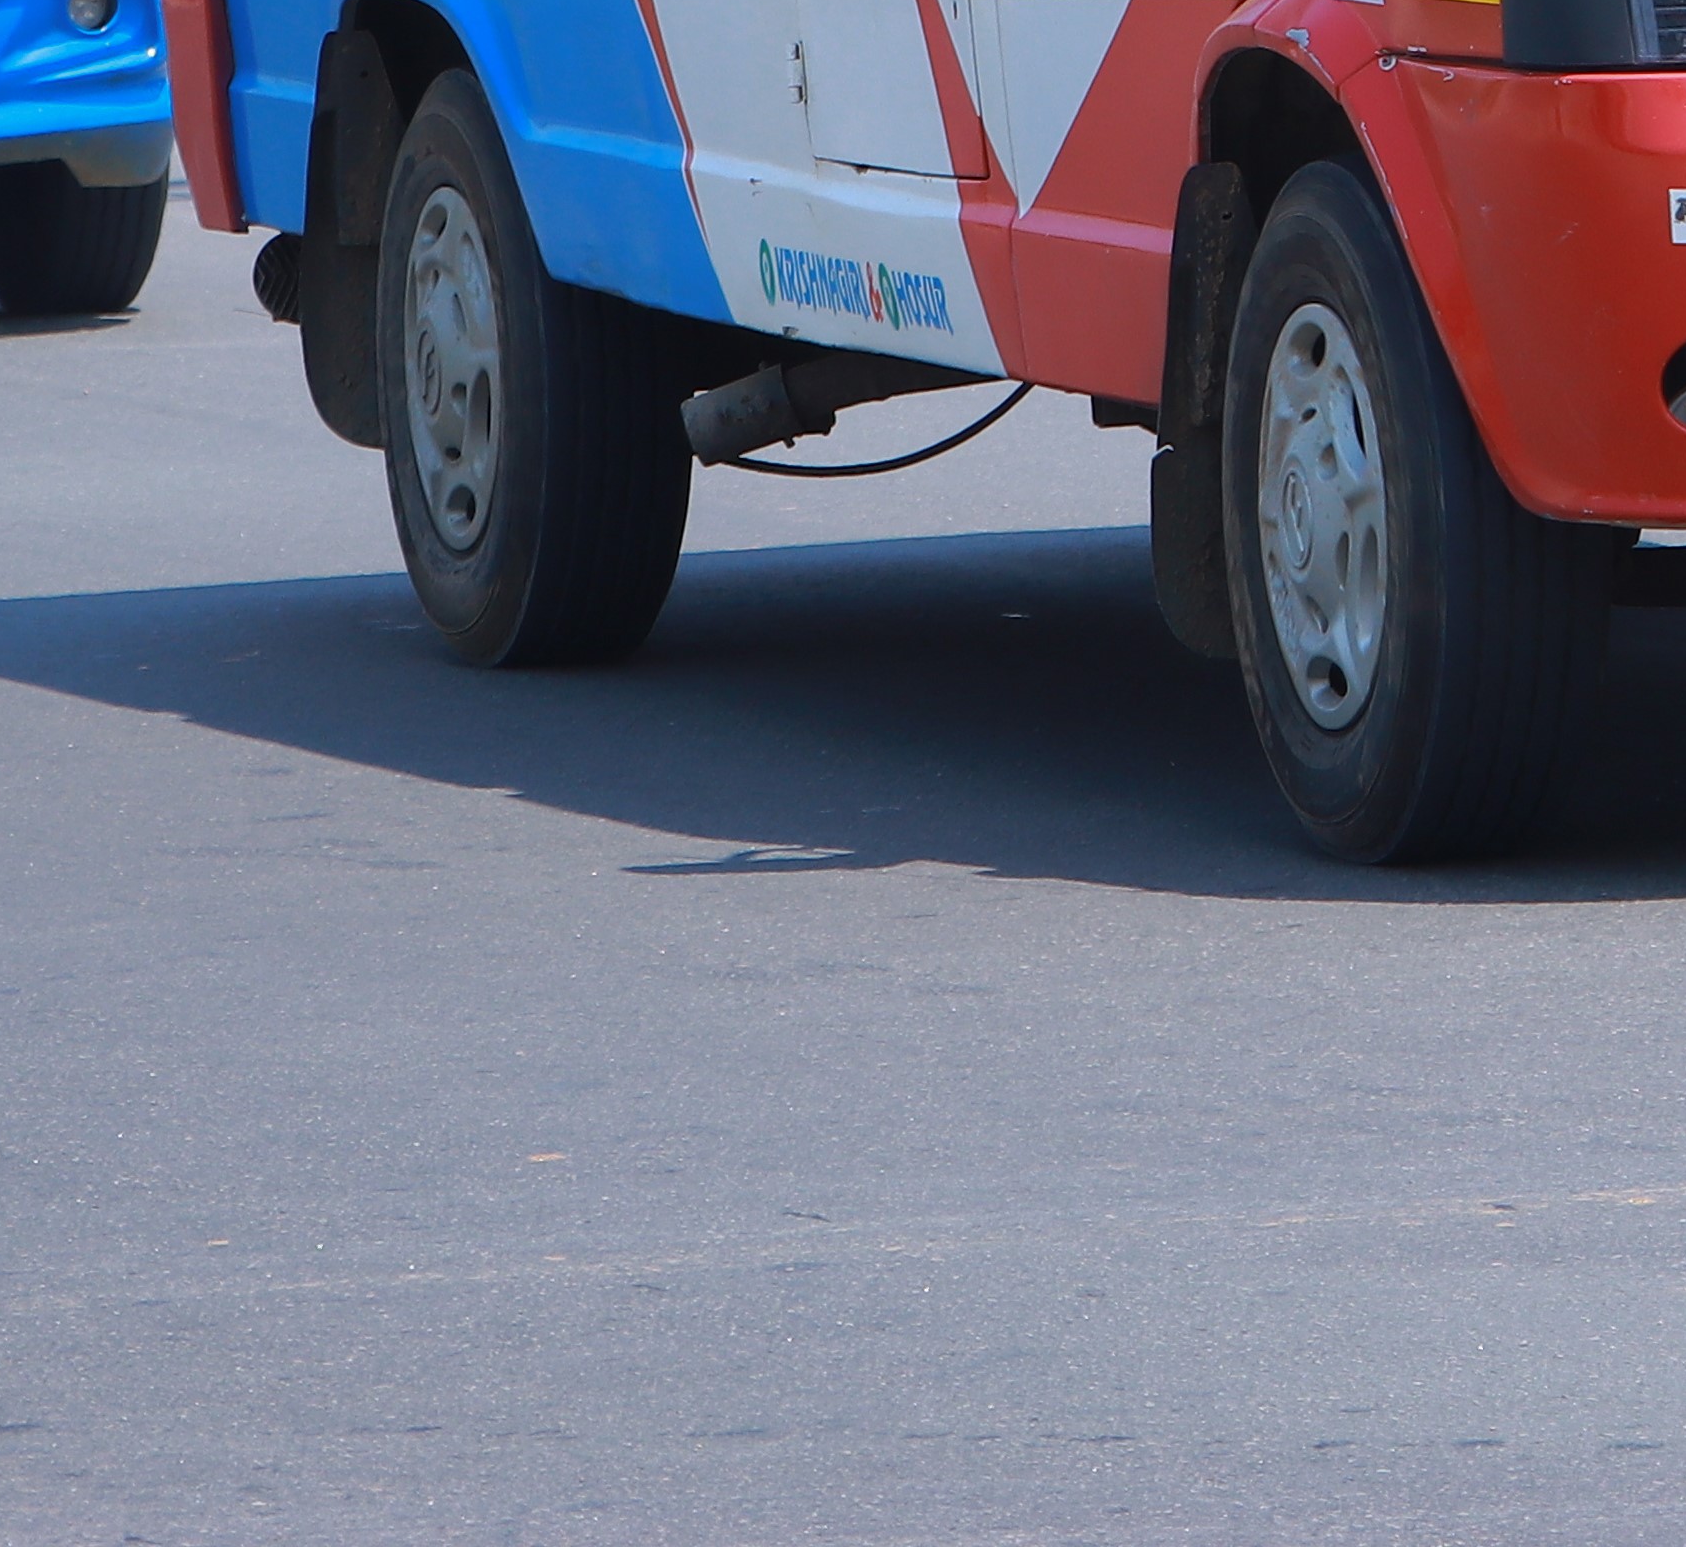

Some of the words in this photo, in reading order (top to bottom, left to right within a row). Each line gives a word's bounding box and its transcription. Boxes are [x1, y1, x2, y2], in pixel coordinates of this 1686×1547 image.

[774, 246, 871, 322] KRISHNAGIRI
[865, 261, 885, 323] &
[891, 270, 955, 337] HOSUR
